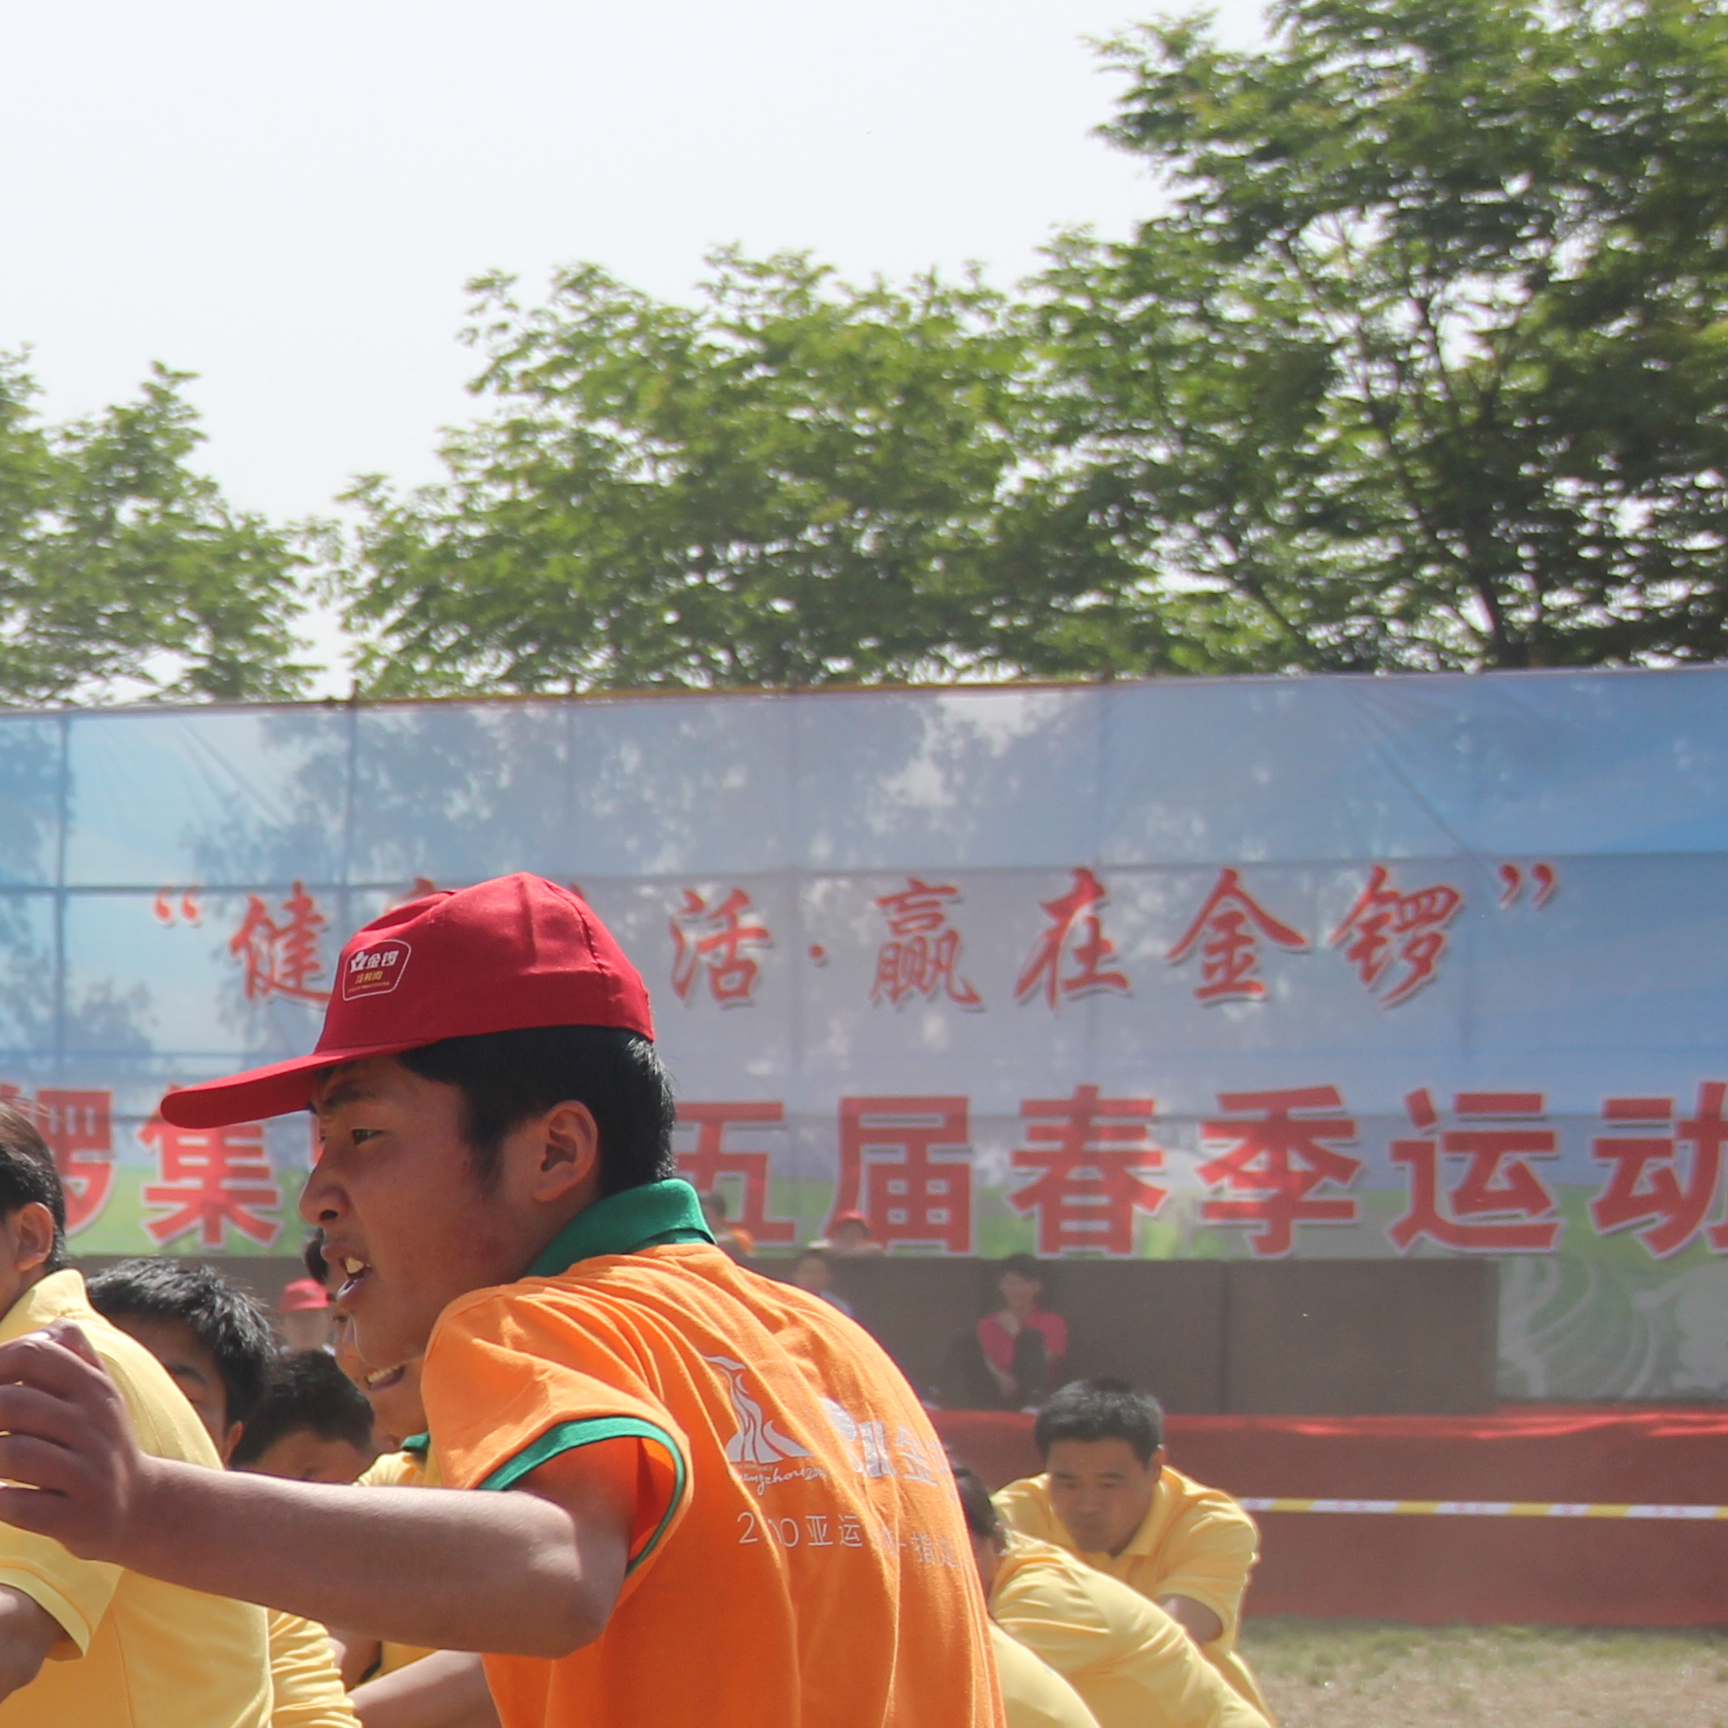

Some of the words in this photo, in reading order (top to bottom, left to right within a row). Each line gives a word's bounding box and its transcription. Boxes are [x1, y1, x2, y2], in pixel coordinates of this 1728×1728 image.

[153, 864, 1557, 1007] “健活·赢在金锣”
